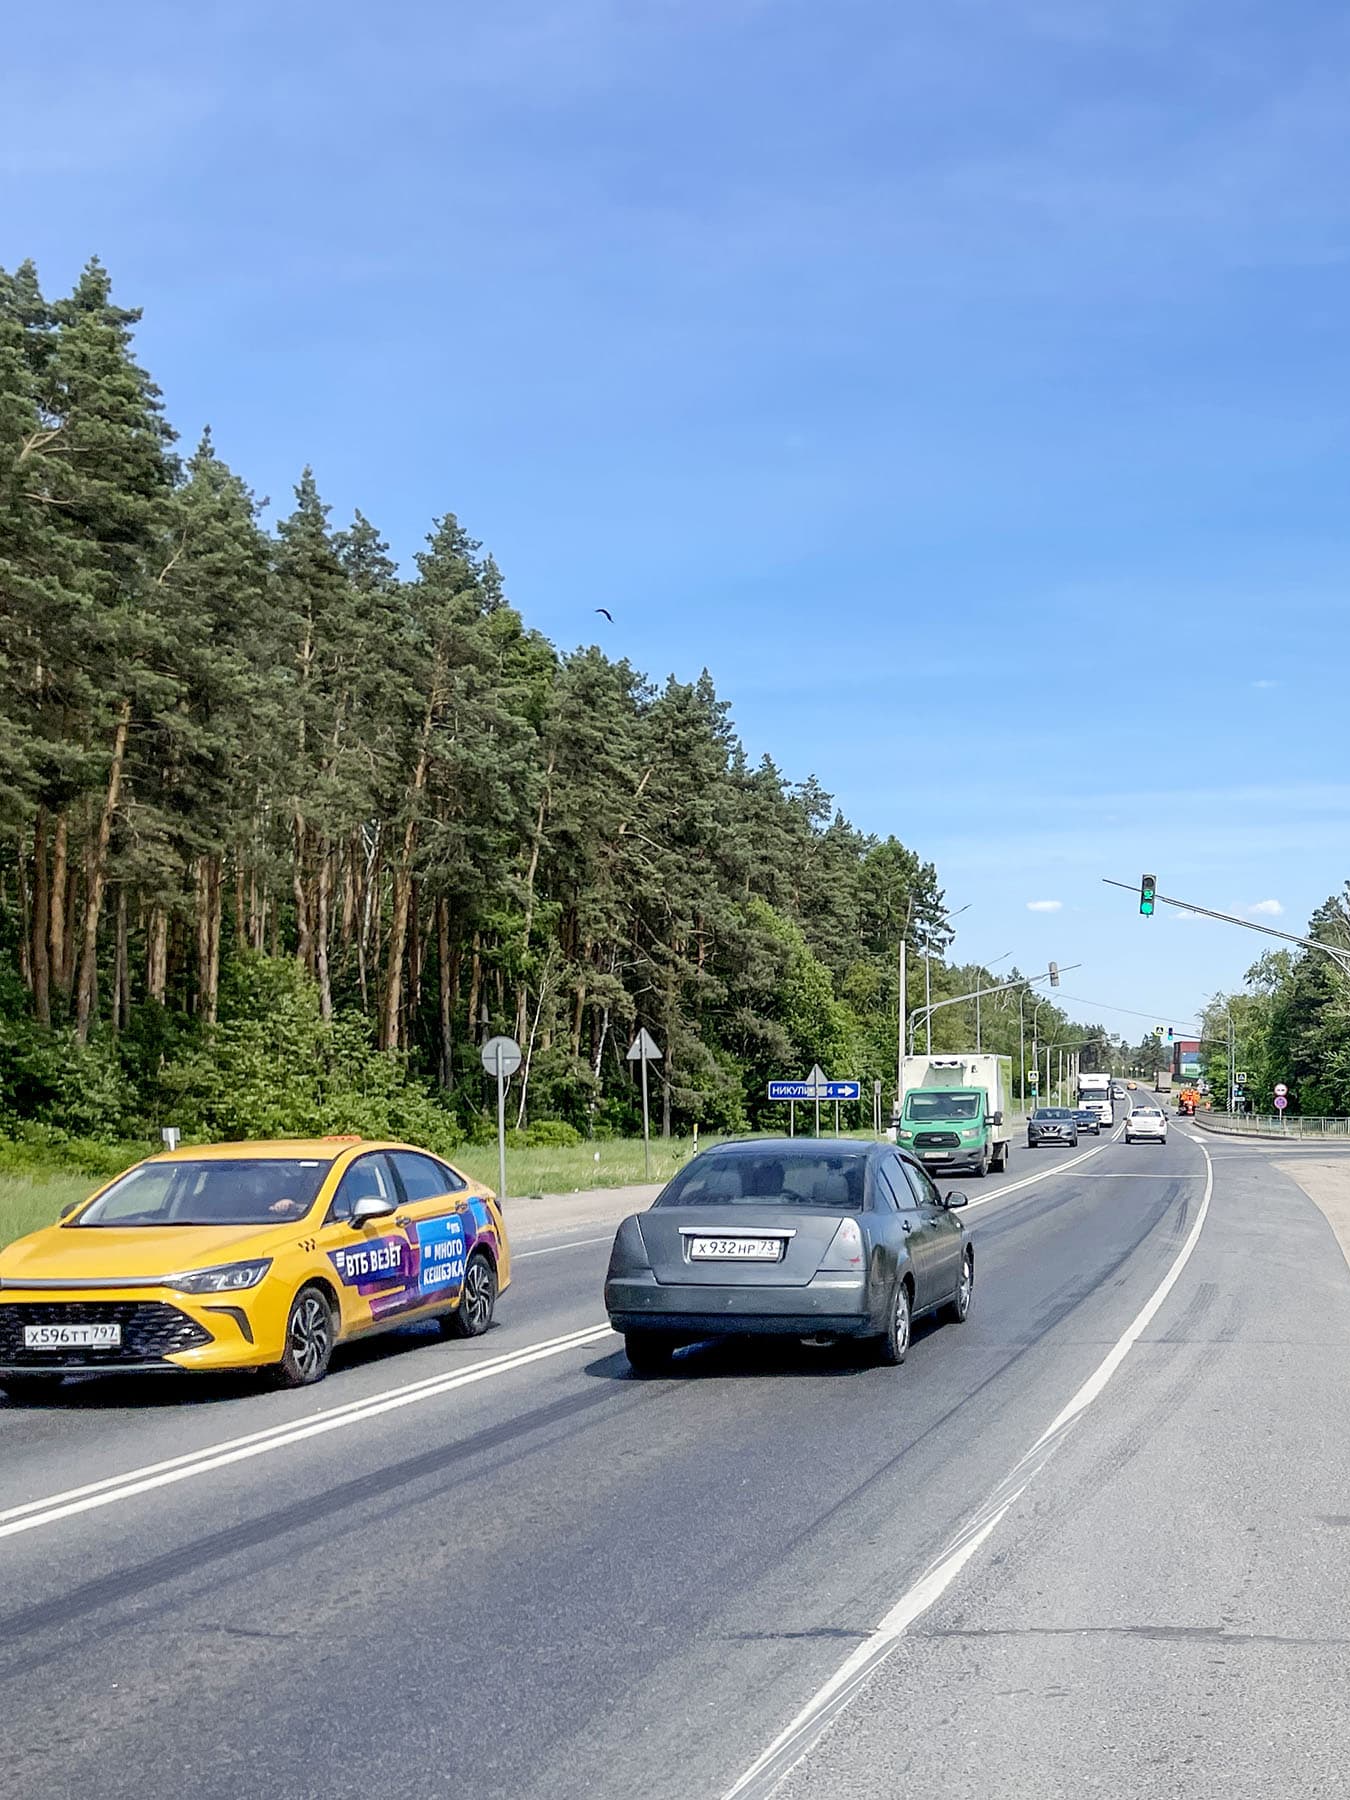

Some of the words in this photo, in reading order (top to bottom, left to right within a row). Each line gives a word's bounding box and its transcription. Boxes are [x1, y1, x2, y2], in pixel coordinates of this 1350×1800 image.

[345, 1252, 369, 1277] ВТБ
[370, 1241, 401, 1272] ВЕЗЁТ
[434, 1238, 463, 1262] МНОГО
[423, 1259, 464, 1286] КЕШБЭКА
